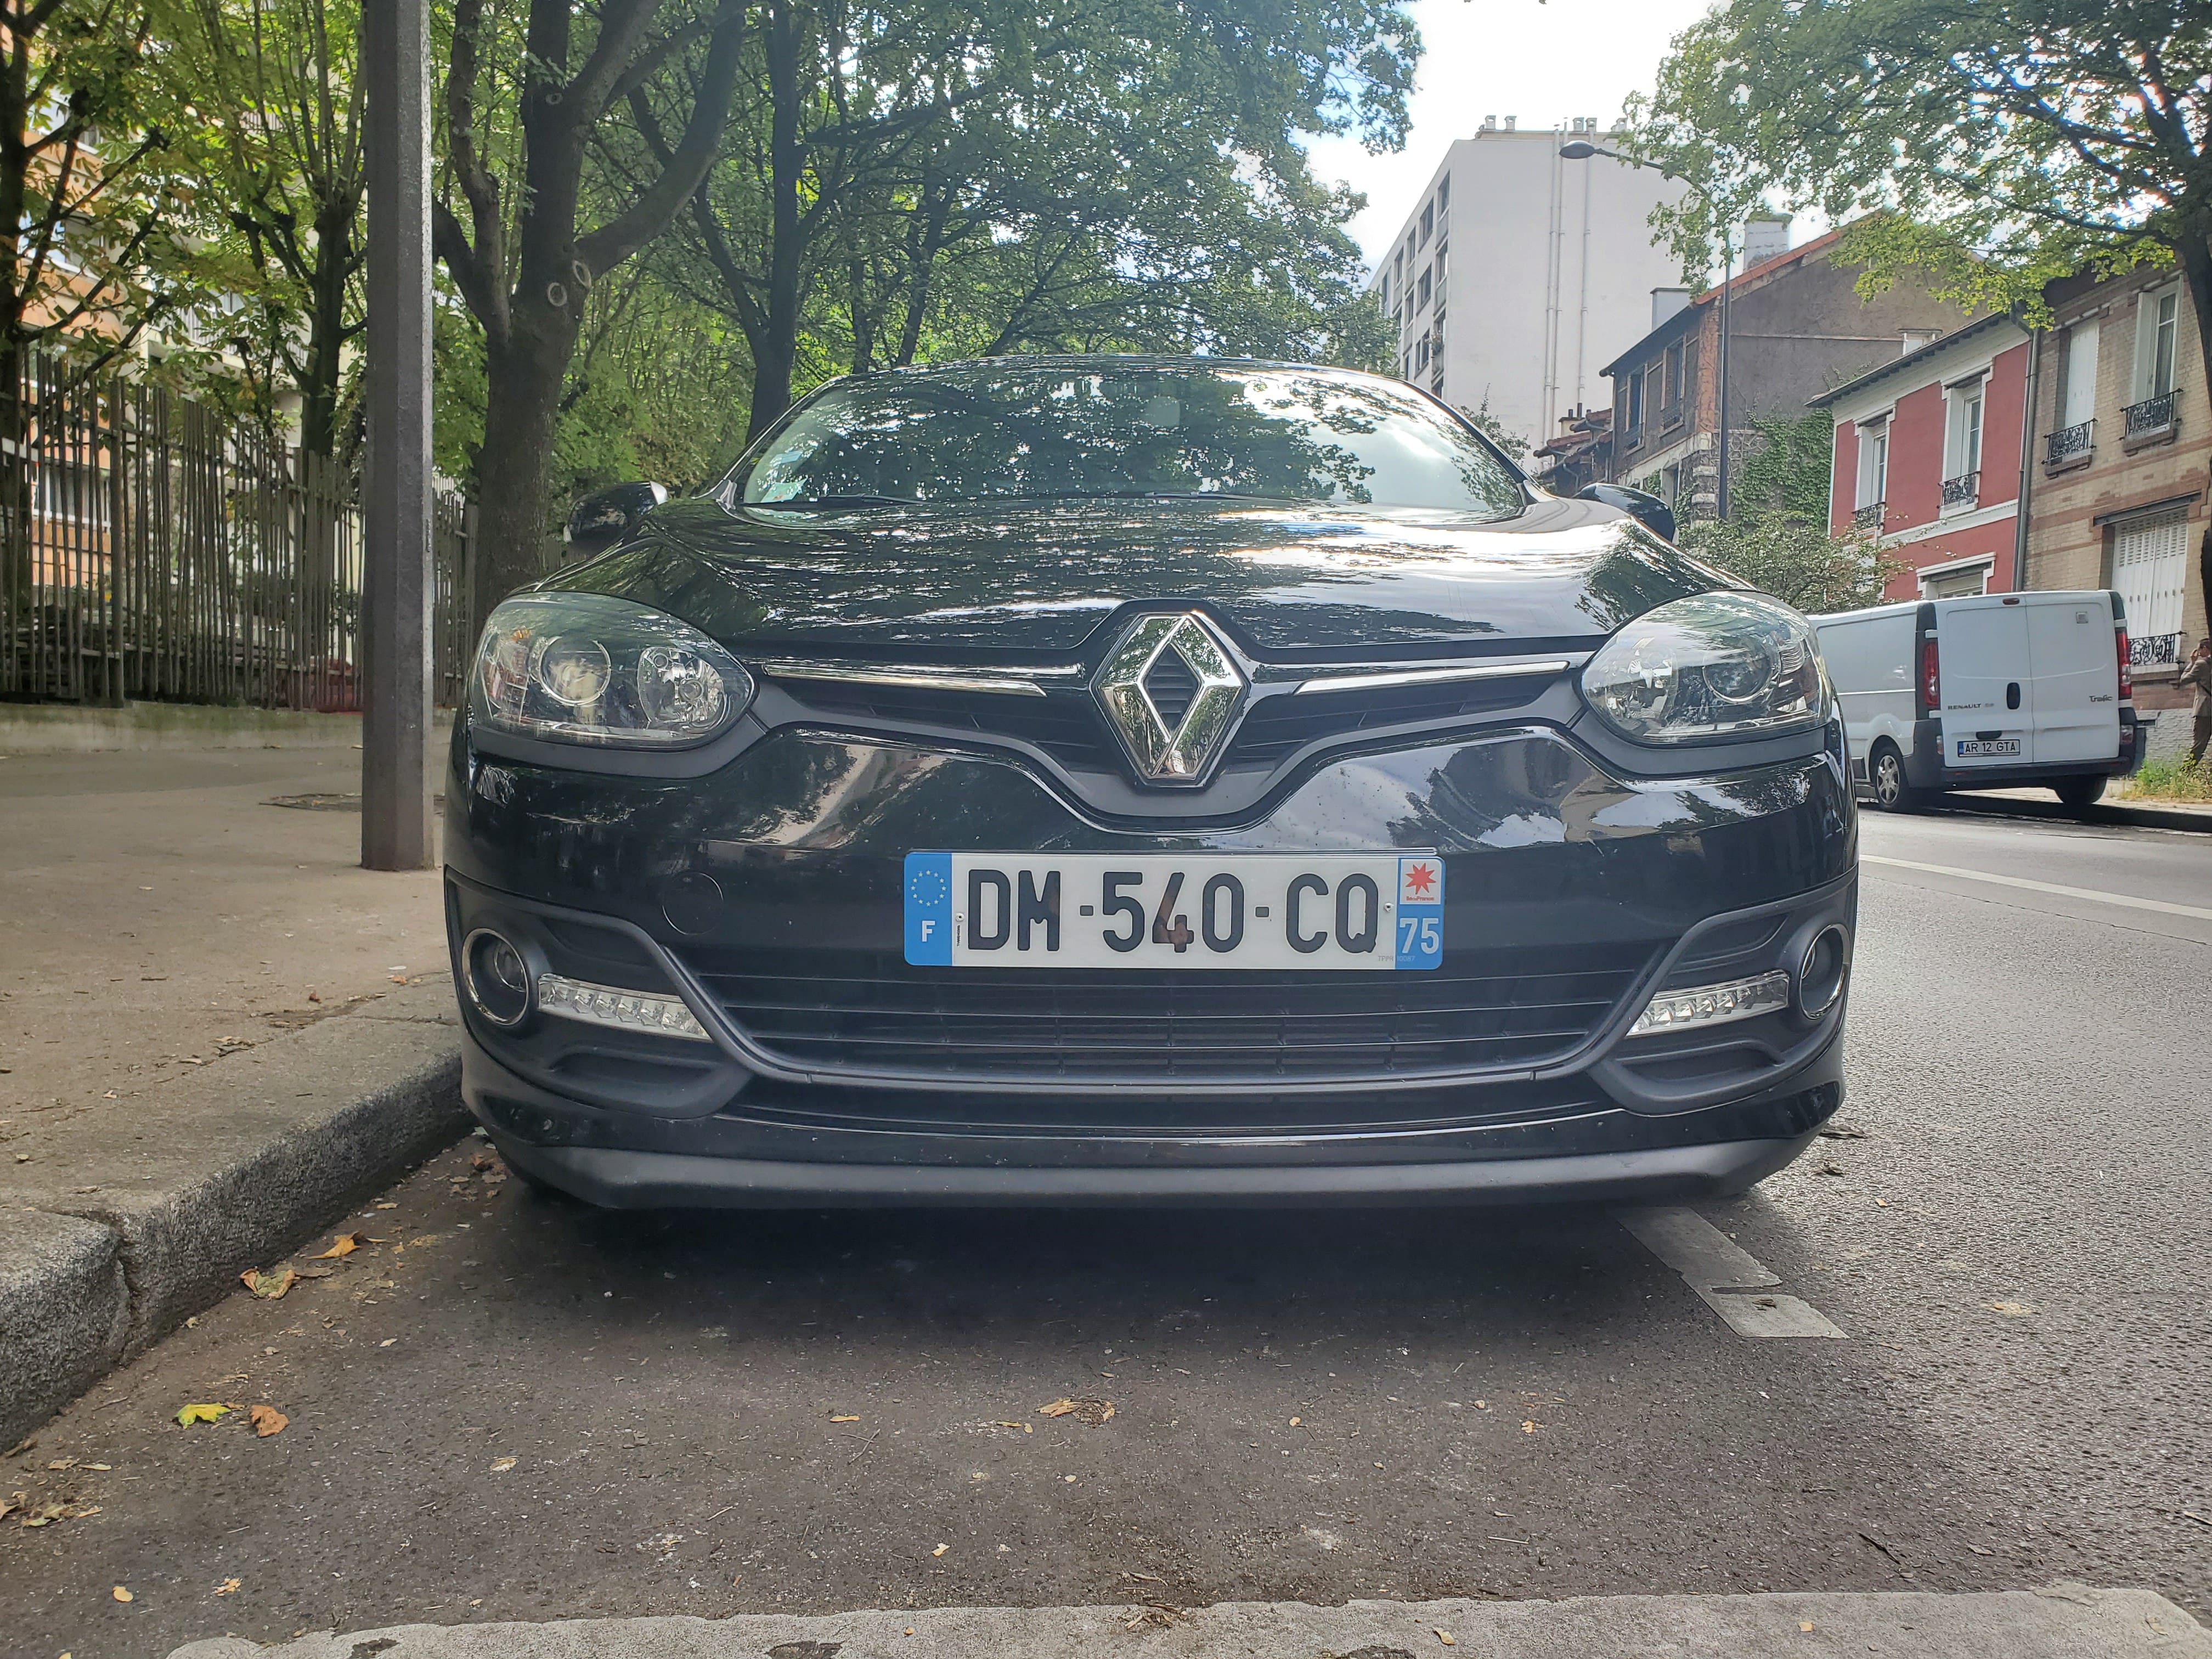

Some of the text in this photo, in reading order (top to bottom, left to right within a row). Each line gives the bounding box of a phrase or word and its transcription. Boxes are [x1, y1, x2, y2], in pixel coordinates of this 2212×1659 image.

[2089, 694, 2113, 702] Trafic
[1965, 742, 2016, 753] AR 12 GTA
[968, 869, 1378, 953] DM-540-CQ
[922, 920, 935, 942] F
[1400, 917, 1439, 954] 75
